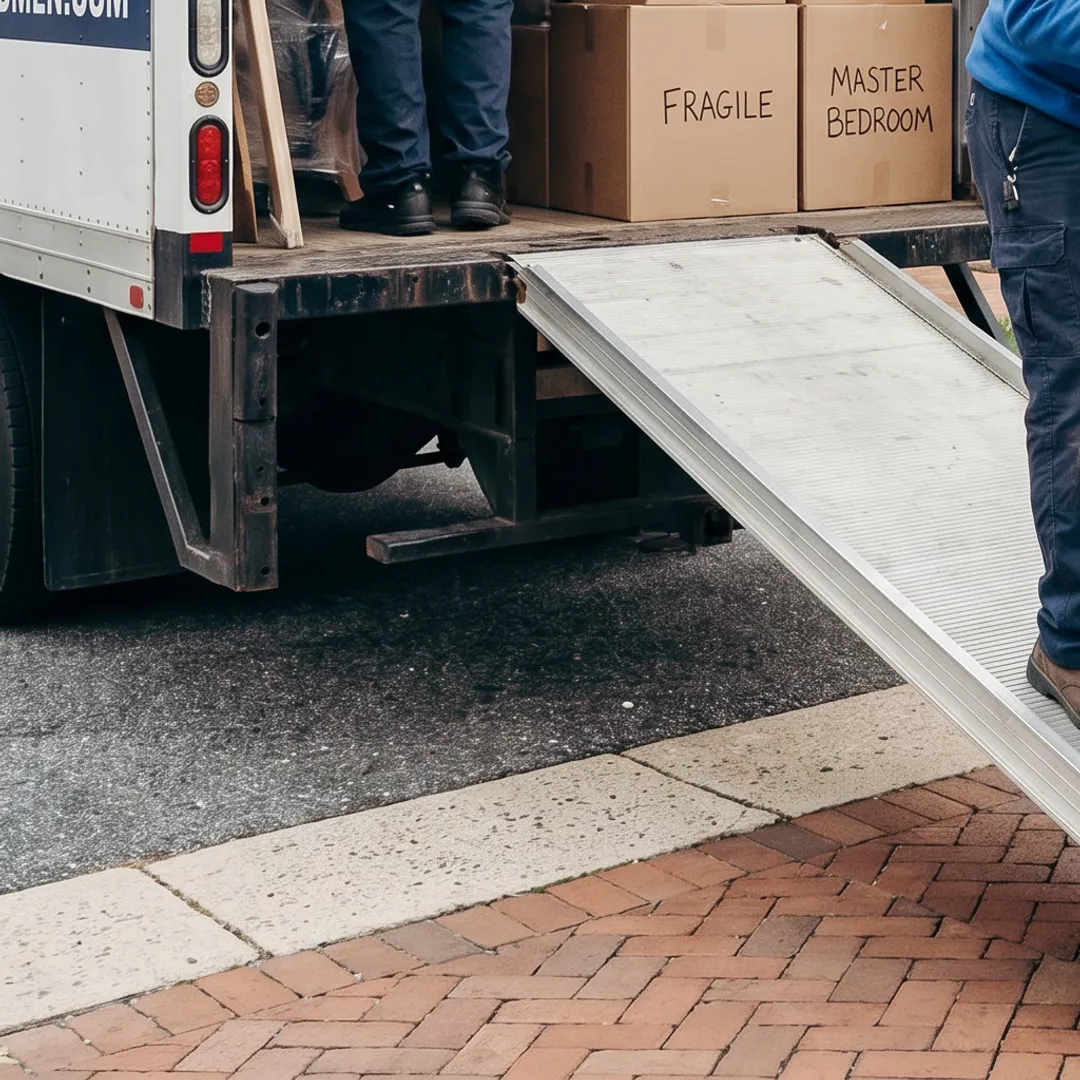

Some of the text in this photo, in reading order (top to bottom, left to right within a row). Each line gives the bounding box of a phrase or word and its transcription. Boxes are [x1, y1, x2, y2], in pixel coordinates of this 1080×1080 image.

[830, 64, 925, 97] MASTER
[663, 87, 774, 125] FRAGILE
[827, 104, 934, 139] BEDROOM
